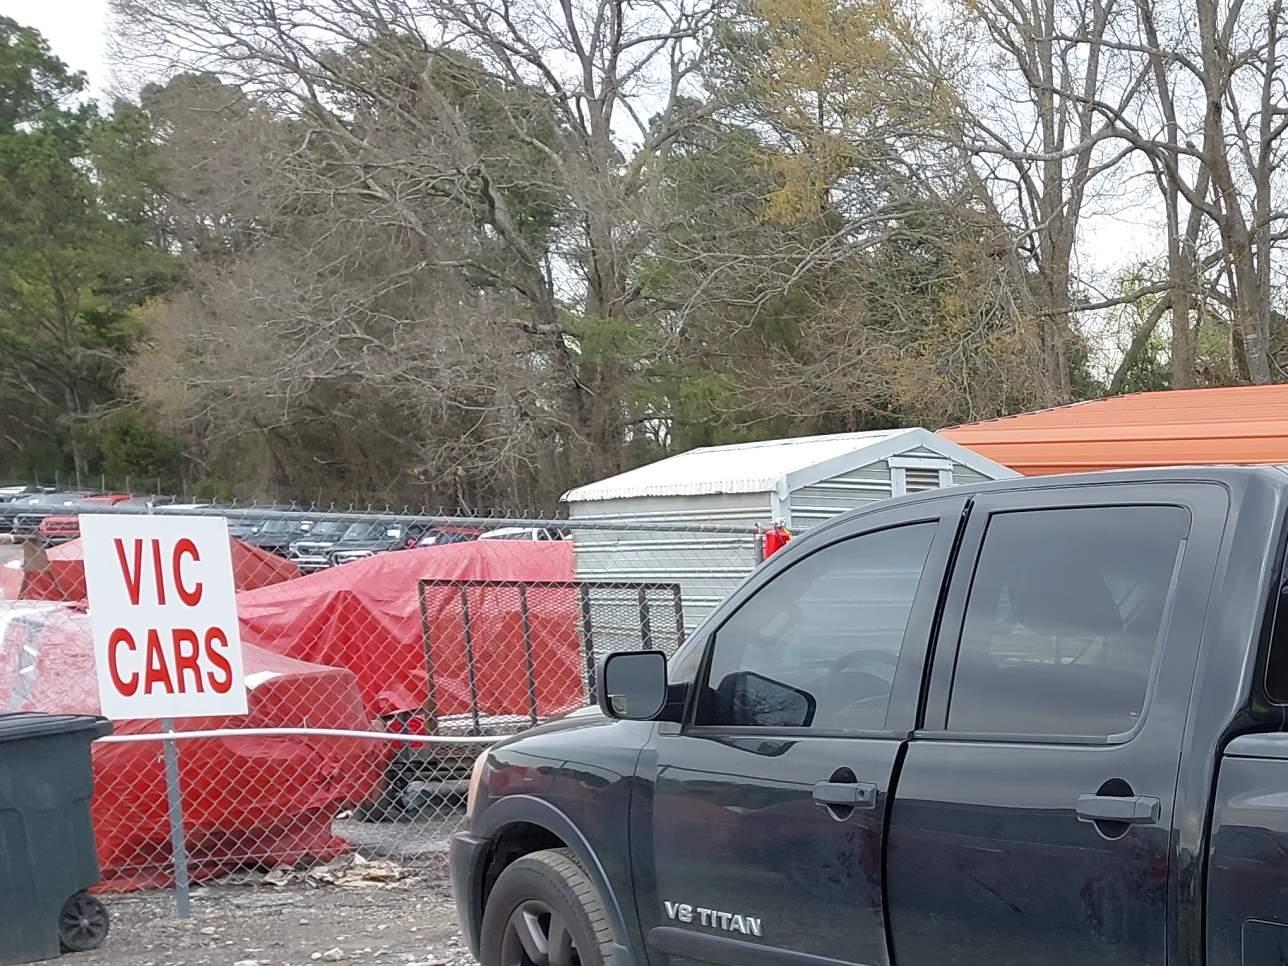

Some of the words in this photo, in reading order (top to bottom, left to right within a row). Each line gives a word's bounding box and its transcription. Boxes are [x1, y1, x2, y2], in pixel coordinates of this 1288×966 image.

[113, 538, 203, 607] VIC
[108, 626, 233, 697] CARS
[697, 907, 763, 937] TITAN
